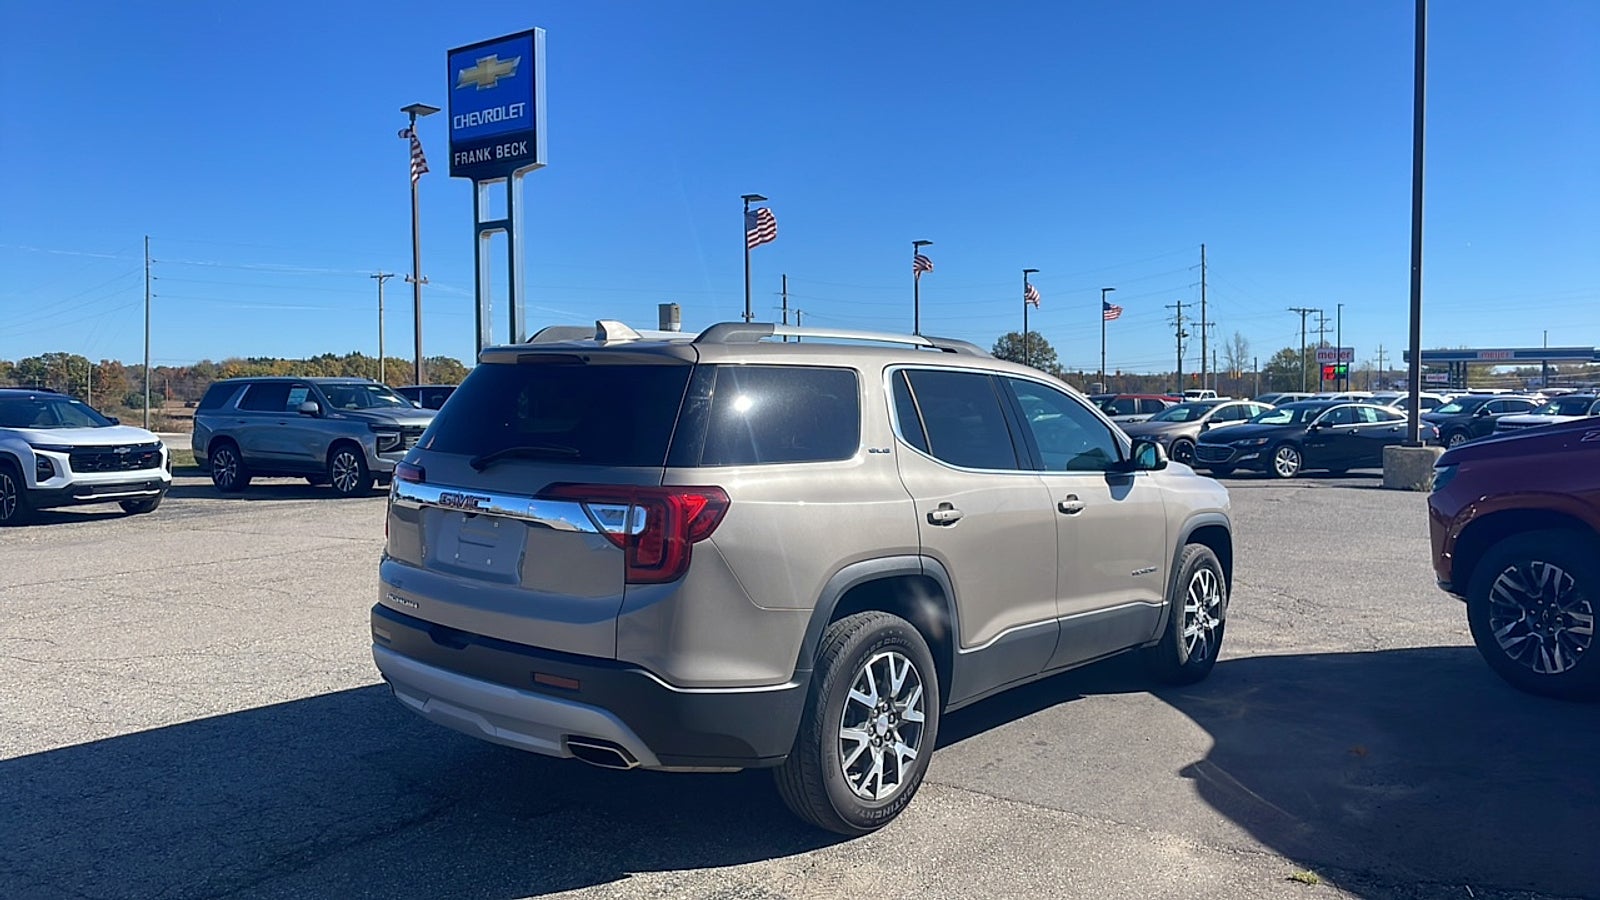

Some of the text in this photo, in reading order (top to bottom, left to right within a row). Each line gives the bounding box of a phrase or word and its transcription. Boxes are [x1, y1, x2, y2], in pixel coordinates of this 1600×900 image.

[453, 103, 526, 129] CHEVROLET
[454, 141, 528, 166] FRANK BECK
[1317, 351, 1351, 360] meier
[439, 492, 491, 513] GMC
